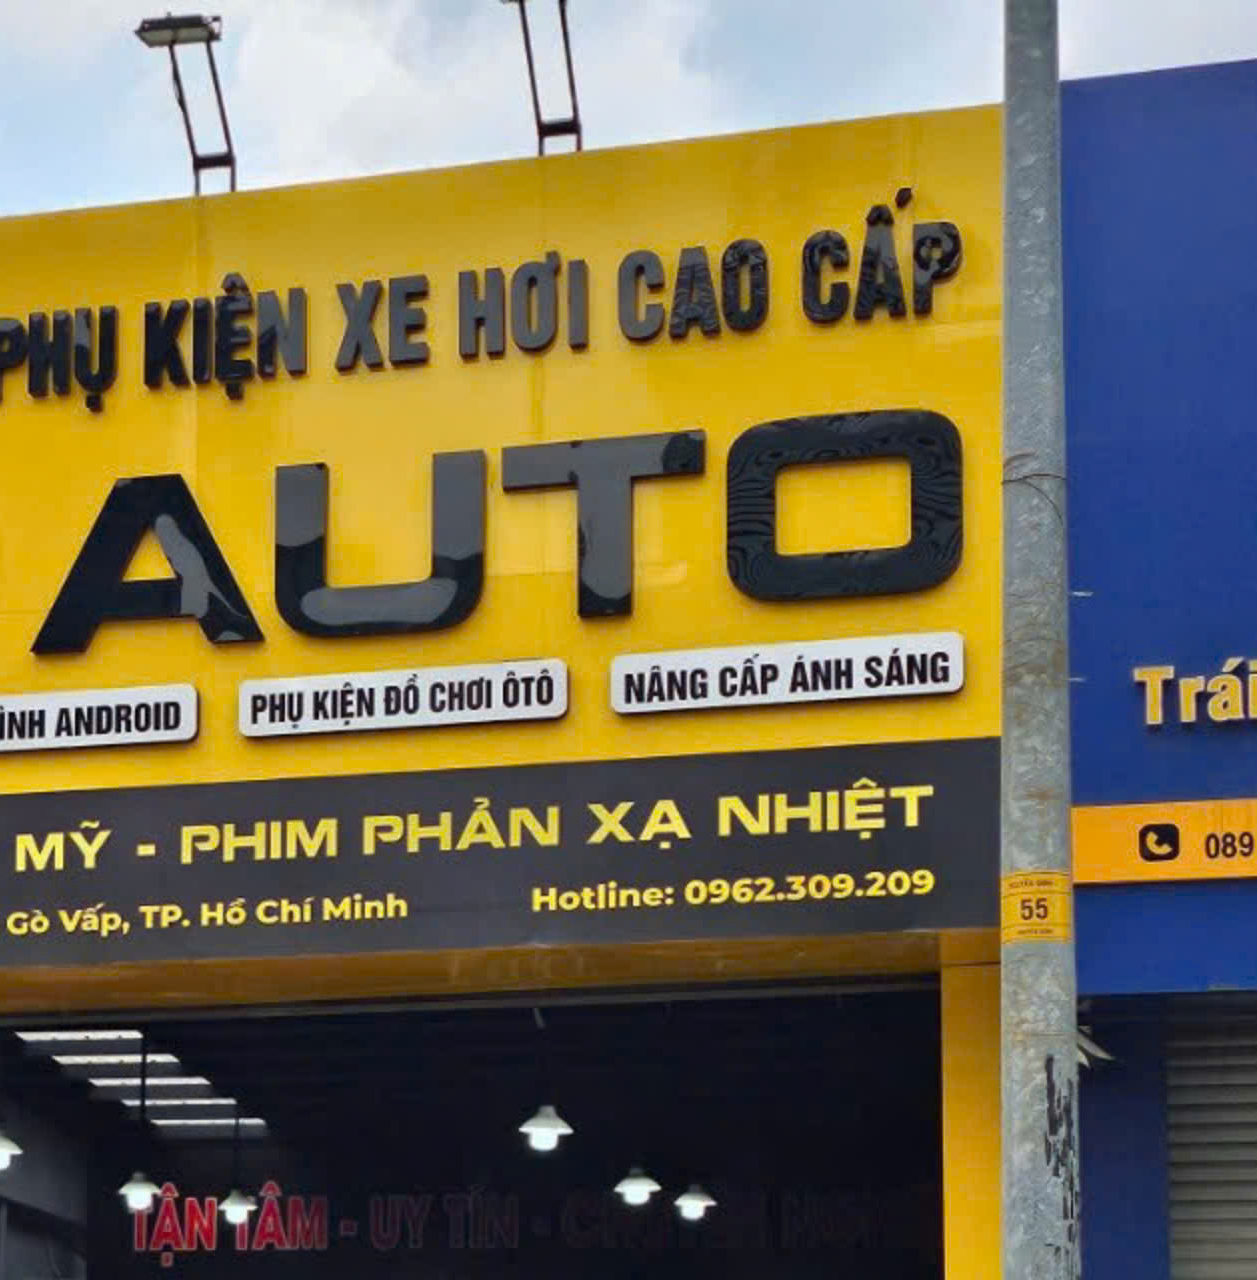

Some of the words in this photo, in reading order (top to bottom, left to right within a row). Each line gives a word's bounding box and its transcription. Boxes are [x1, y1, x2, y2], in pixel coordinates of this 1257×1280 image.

[144, 272, 308, 404] KIỆN
[335, 272, 430, 373] XE
[458, 250, 590, 360] HƠI
[617, 237, 770, 341] CAO
[801, 186, 964, 325] CẤP
[30, 407, 965, 656] AUTO
[250, 691, 305, 731] PHỤ
[312, 685, 377, 728] KIỆN
[383, 675, 423, 715] ĐỒ
[429, 674, 494, 713] CHƠI
[502, 669, 554, 708] ÔTÔ
[624, 664, 709, 703] NÂNG
[719, 651, 781, 698] CẤP
[788, 654, 853, 693] ÁNH
[863, 647, 951, 689] SÁNG
[53, 700, 183, 739] ANDROID
[15, 820, 111, 872] MỸ
[180, 817, 339, 864] PHIM
[363, 796, 561, 856] PHẢN
[586, 799, 691, 850] XẠ
[717, 777, 934, 841] NHIỆT
[6, 907, 50, 937] Gò
[60, 902, 131, 938] Vấp,
[139, 906, 190, 929] TP.
[200, 895, 246, 926] Hồ
[255, 895, 313, 924] Chí
[322, 893, 408, 920] Minh
[532, 881, 675, 913] Hotline:
[684, 868, 935, 907] 0962.309.209
[1020, 897, 1049, 921] 55
